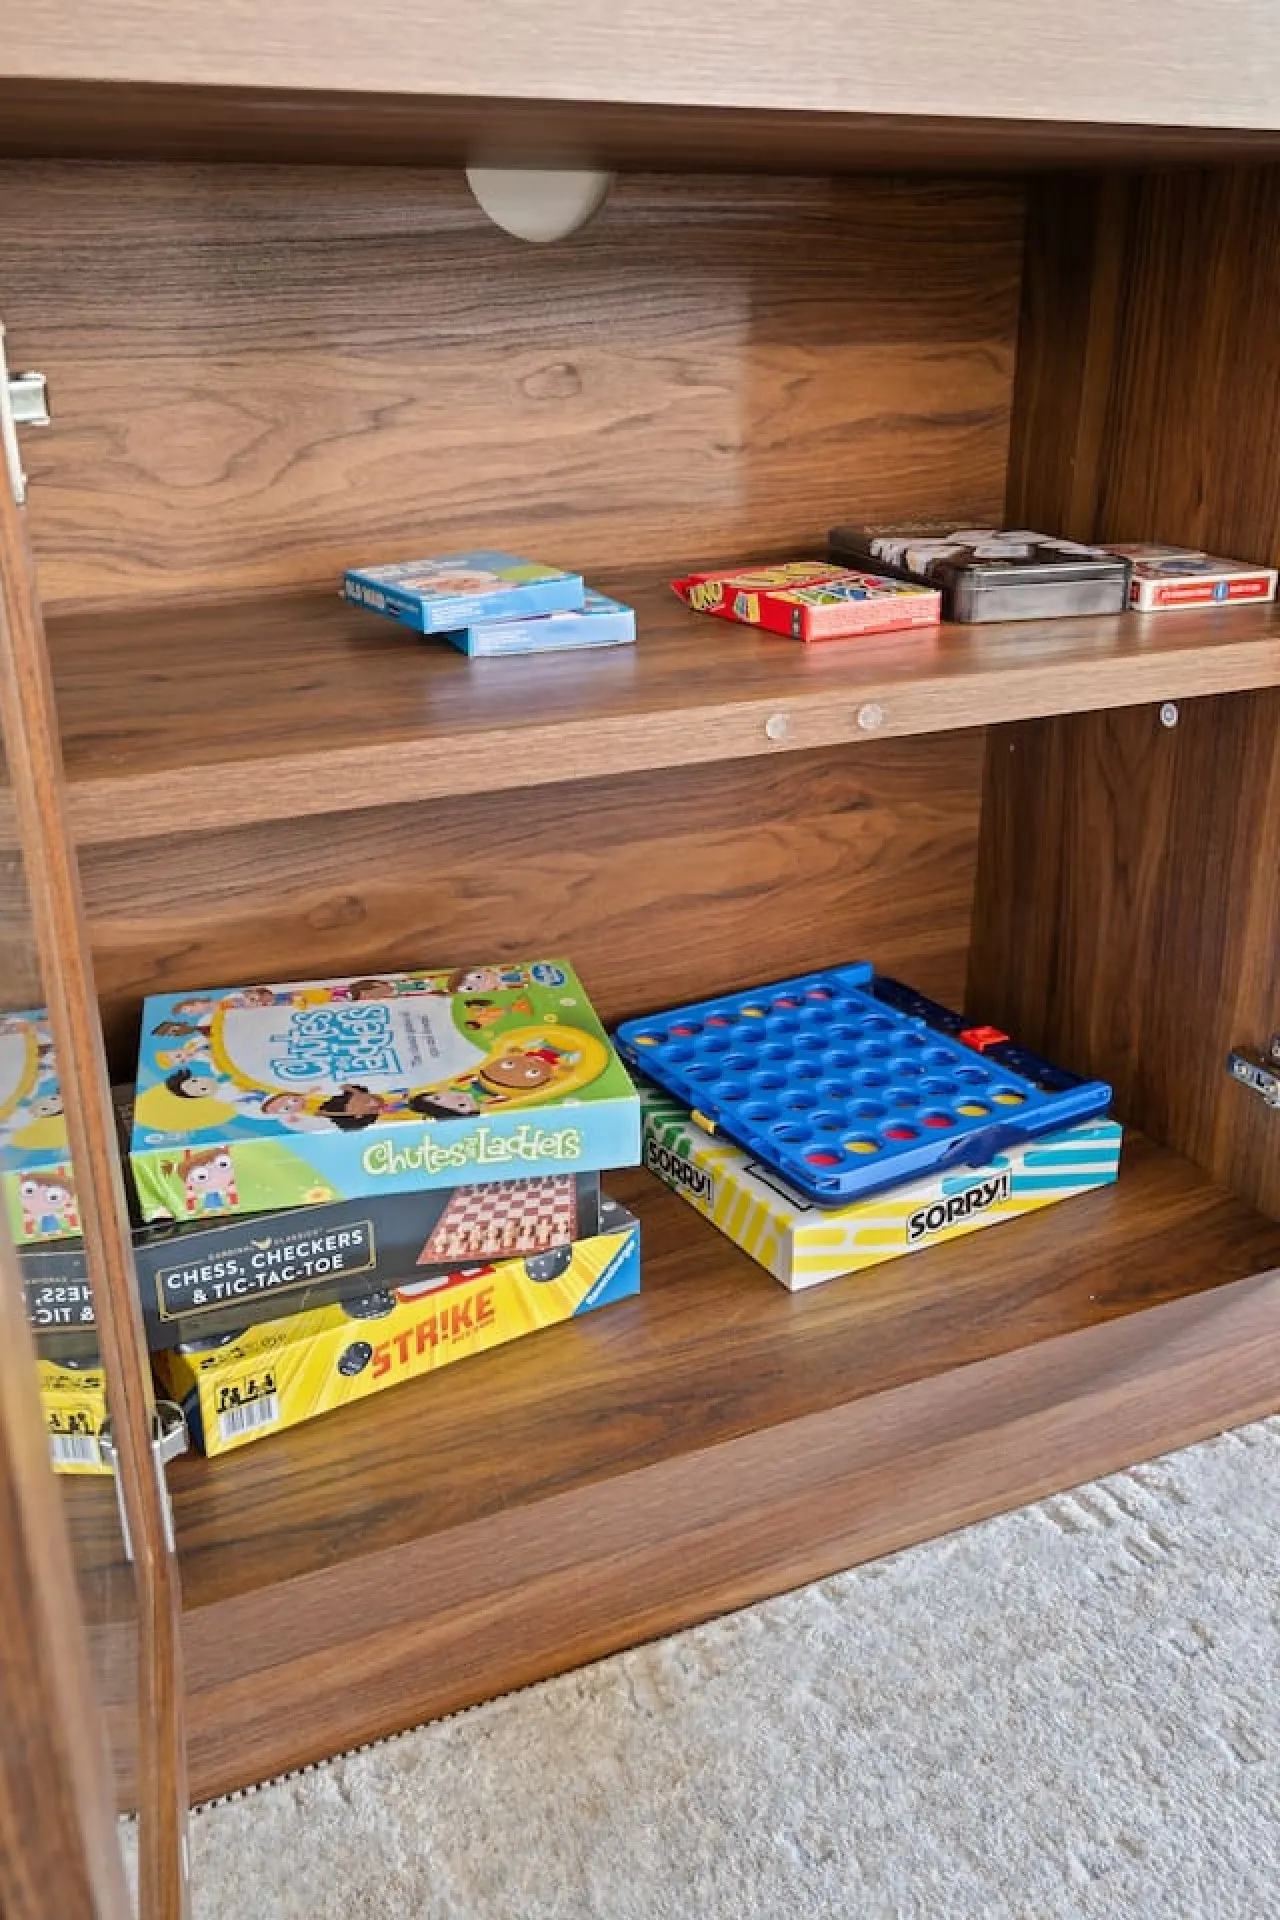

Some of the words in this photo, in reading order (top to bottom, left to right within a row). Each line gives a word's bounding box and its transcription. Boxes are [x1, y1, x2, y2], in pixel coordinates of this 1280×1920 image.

[362, 1132, 467, 1175] Chutes
[474, 1124, 582, 1164] Ladders
[649, 1141, 711, 1201] SORRY!
[911, 1175, 1007, 1239] SORRY!
[167, 1260, 245, 1289] CHESS,
[251, 1229, 363, 1268] CHECKERS
[193, 1290, 208, 1304] &
[212, 1254, 344, 1299] TIC-TAC-TOE
